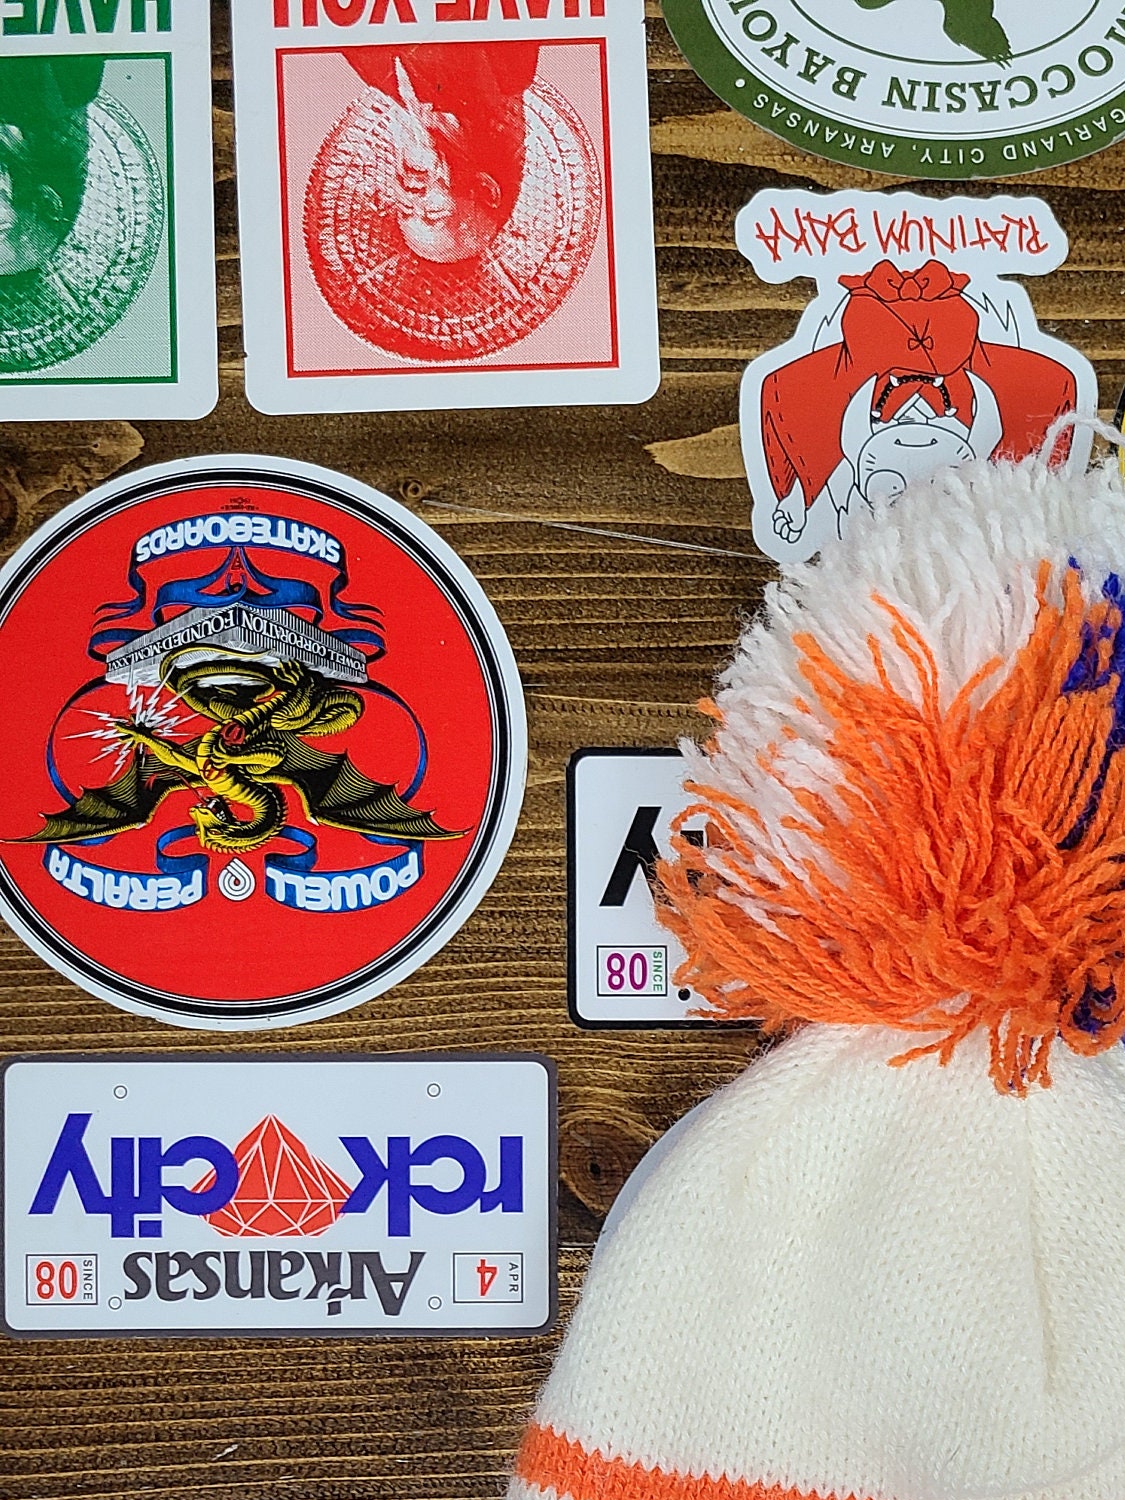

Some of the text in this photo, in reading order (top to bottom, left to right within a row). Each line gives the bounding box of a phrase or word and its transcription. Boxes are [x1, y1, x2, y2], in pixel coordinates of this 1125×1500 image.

[752, 93, 895, 159] ARKANSAS
[911, 143, 985, 165] CITY,
[755, 207, 1049, 262] PLATINUM BAKA
[135, 515, 340, 563] SKATEBOARDS
[241, 609, 366, 673] POWELL CORPORATION
[48, 848, 419, 912] POWELL PERALTA
[652, 951, 663, 992] SINCE
[28, 1113, 240, 1238] city
[339, 1135, 523, 1236] rck
[82, 1259, 93, 1301] SINCE
[122, 1250, 425, 1316] Arkansas
[476, 1259, 497, 1296] 4
[508, 1261, 519, 1294] APR
